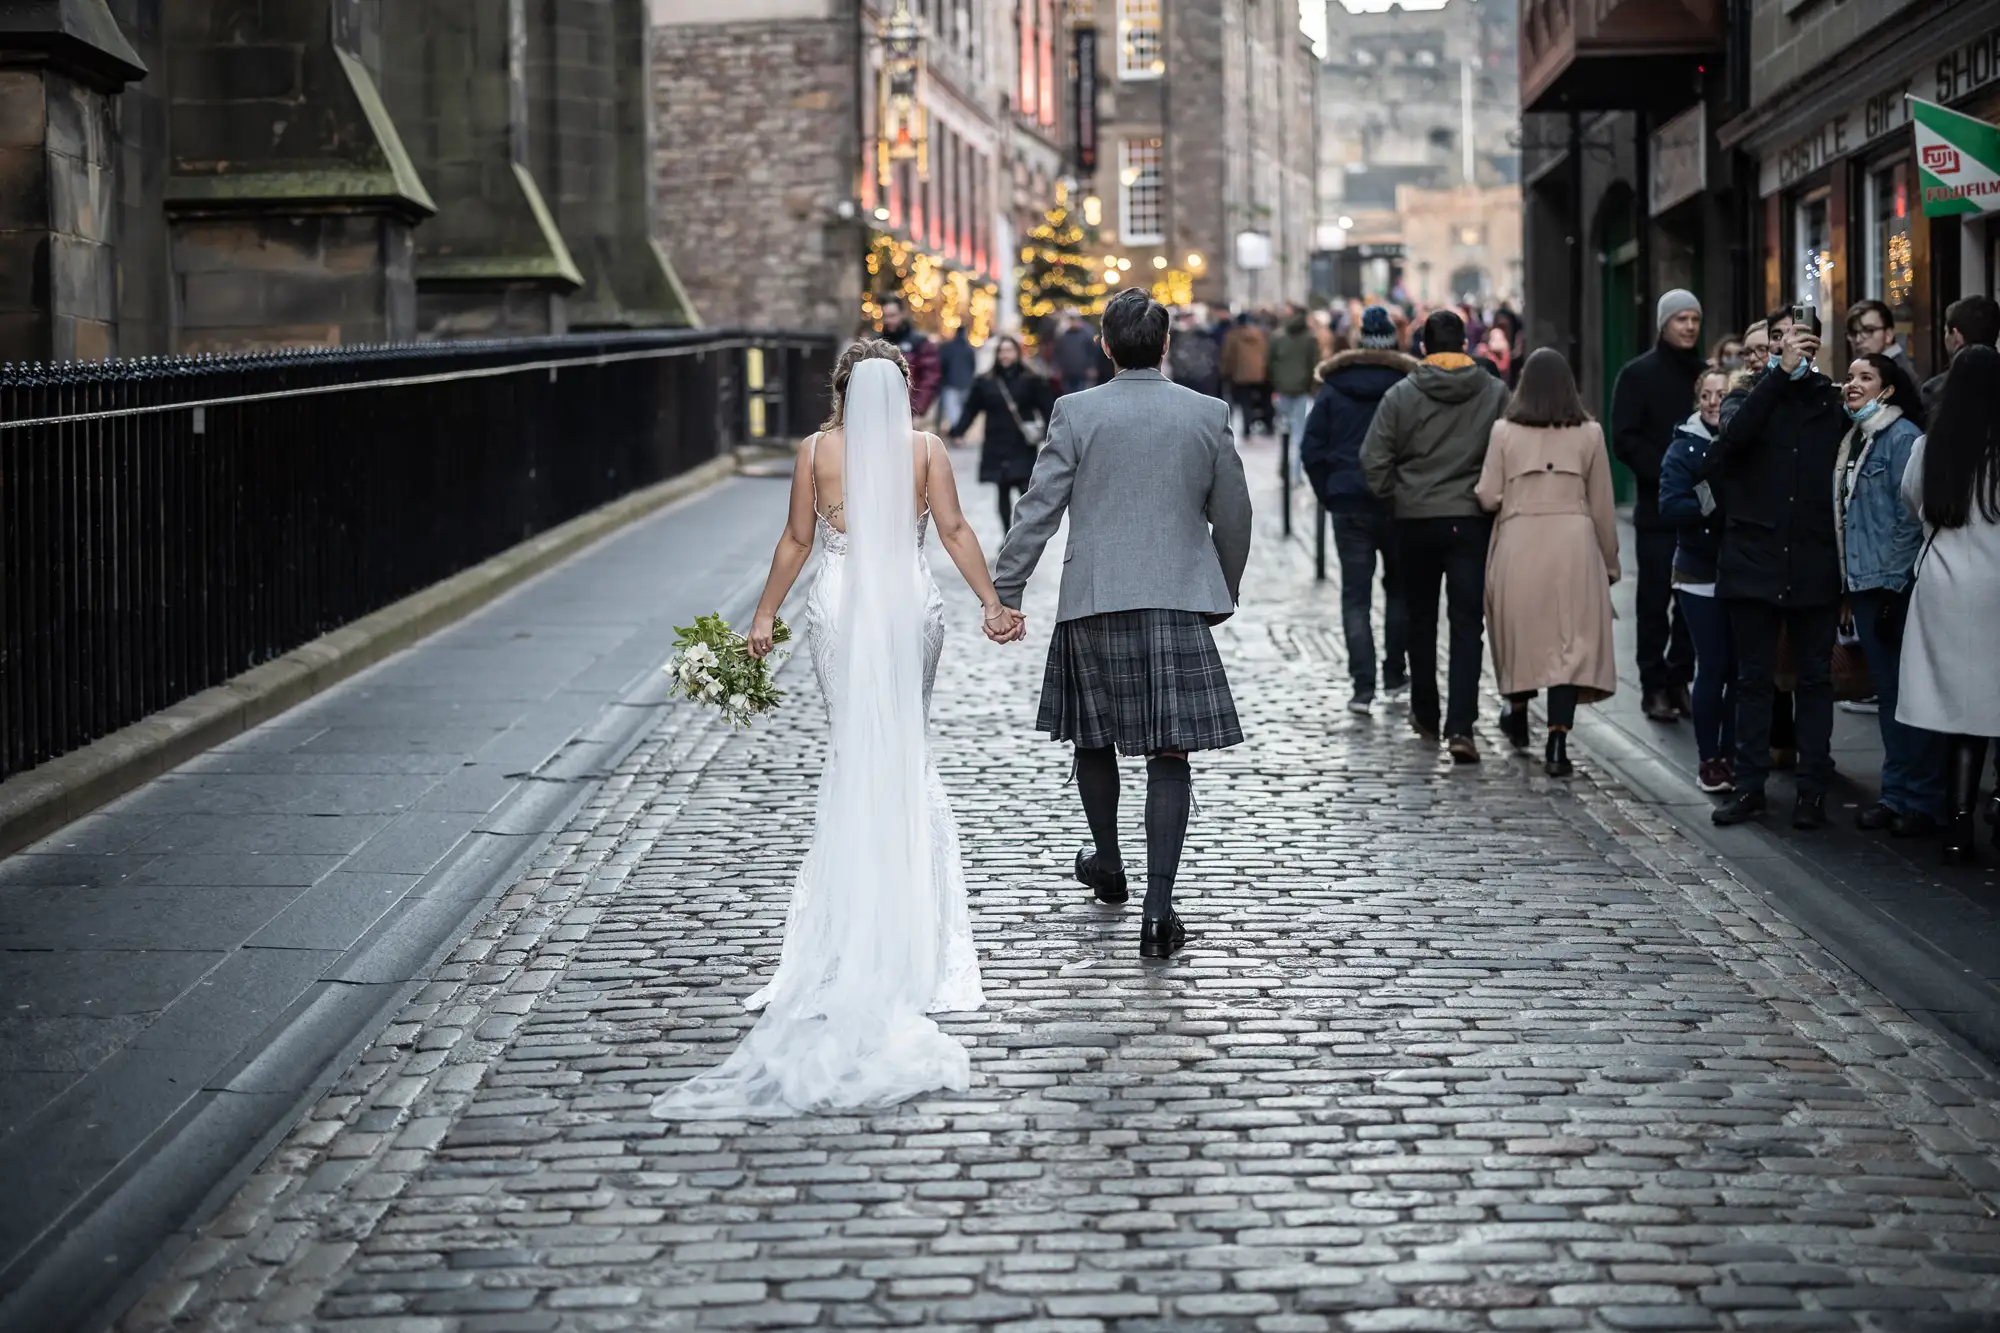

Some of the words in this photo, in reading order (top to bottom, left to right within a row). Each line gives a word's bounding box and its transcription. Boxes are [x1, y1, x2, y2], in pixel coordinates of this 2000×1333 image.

[1779, 113, 1849, 184] CASTLE
[1867, 77, 1913, 138] GIFT
[1927, 179, 2000, 203] FUJIFILM
